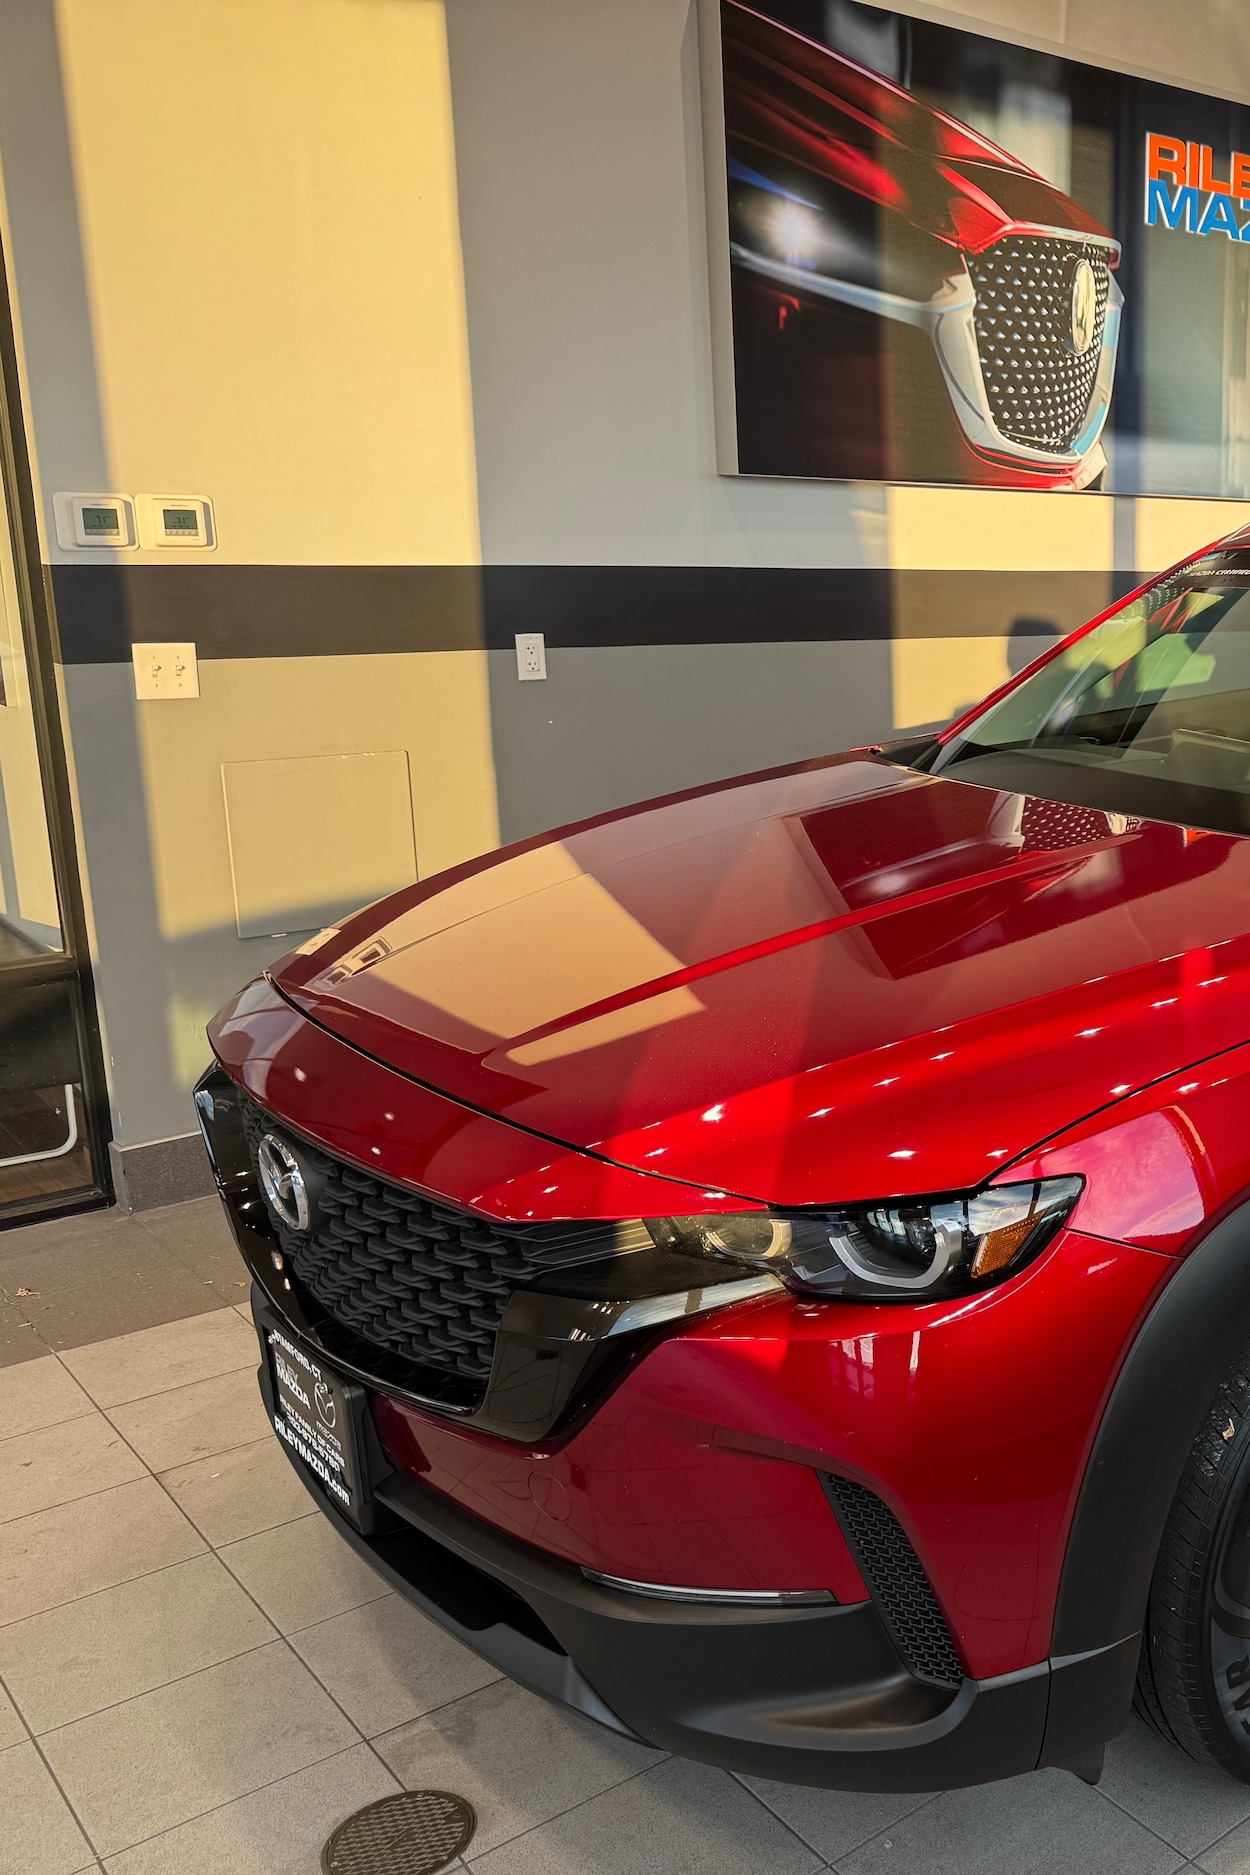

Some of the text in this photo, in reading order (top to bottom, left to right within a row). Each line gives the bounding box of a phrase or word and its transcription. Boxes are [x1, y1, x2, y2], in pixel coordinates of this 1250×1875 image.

[274, 1350, 299, 1386] RILEY
[276, 1363, 311, 1410] MAZDA
[274, 1414, 350, 1507] RILEYMAZDA.com
[326, 1443, 346, 1468] CARS
